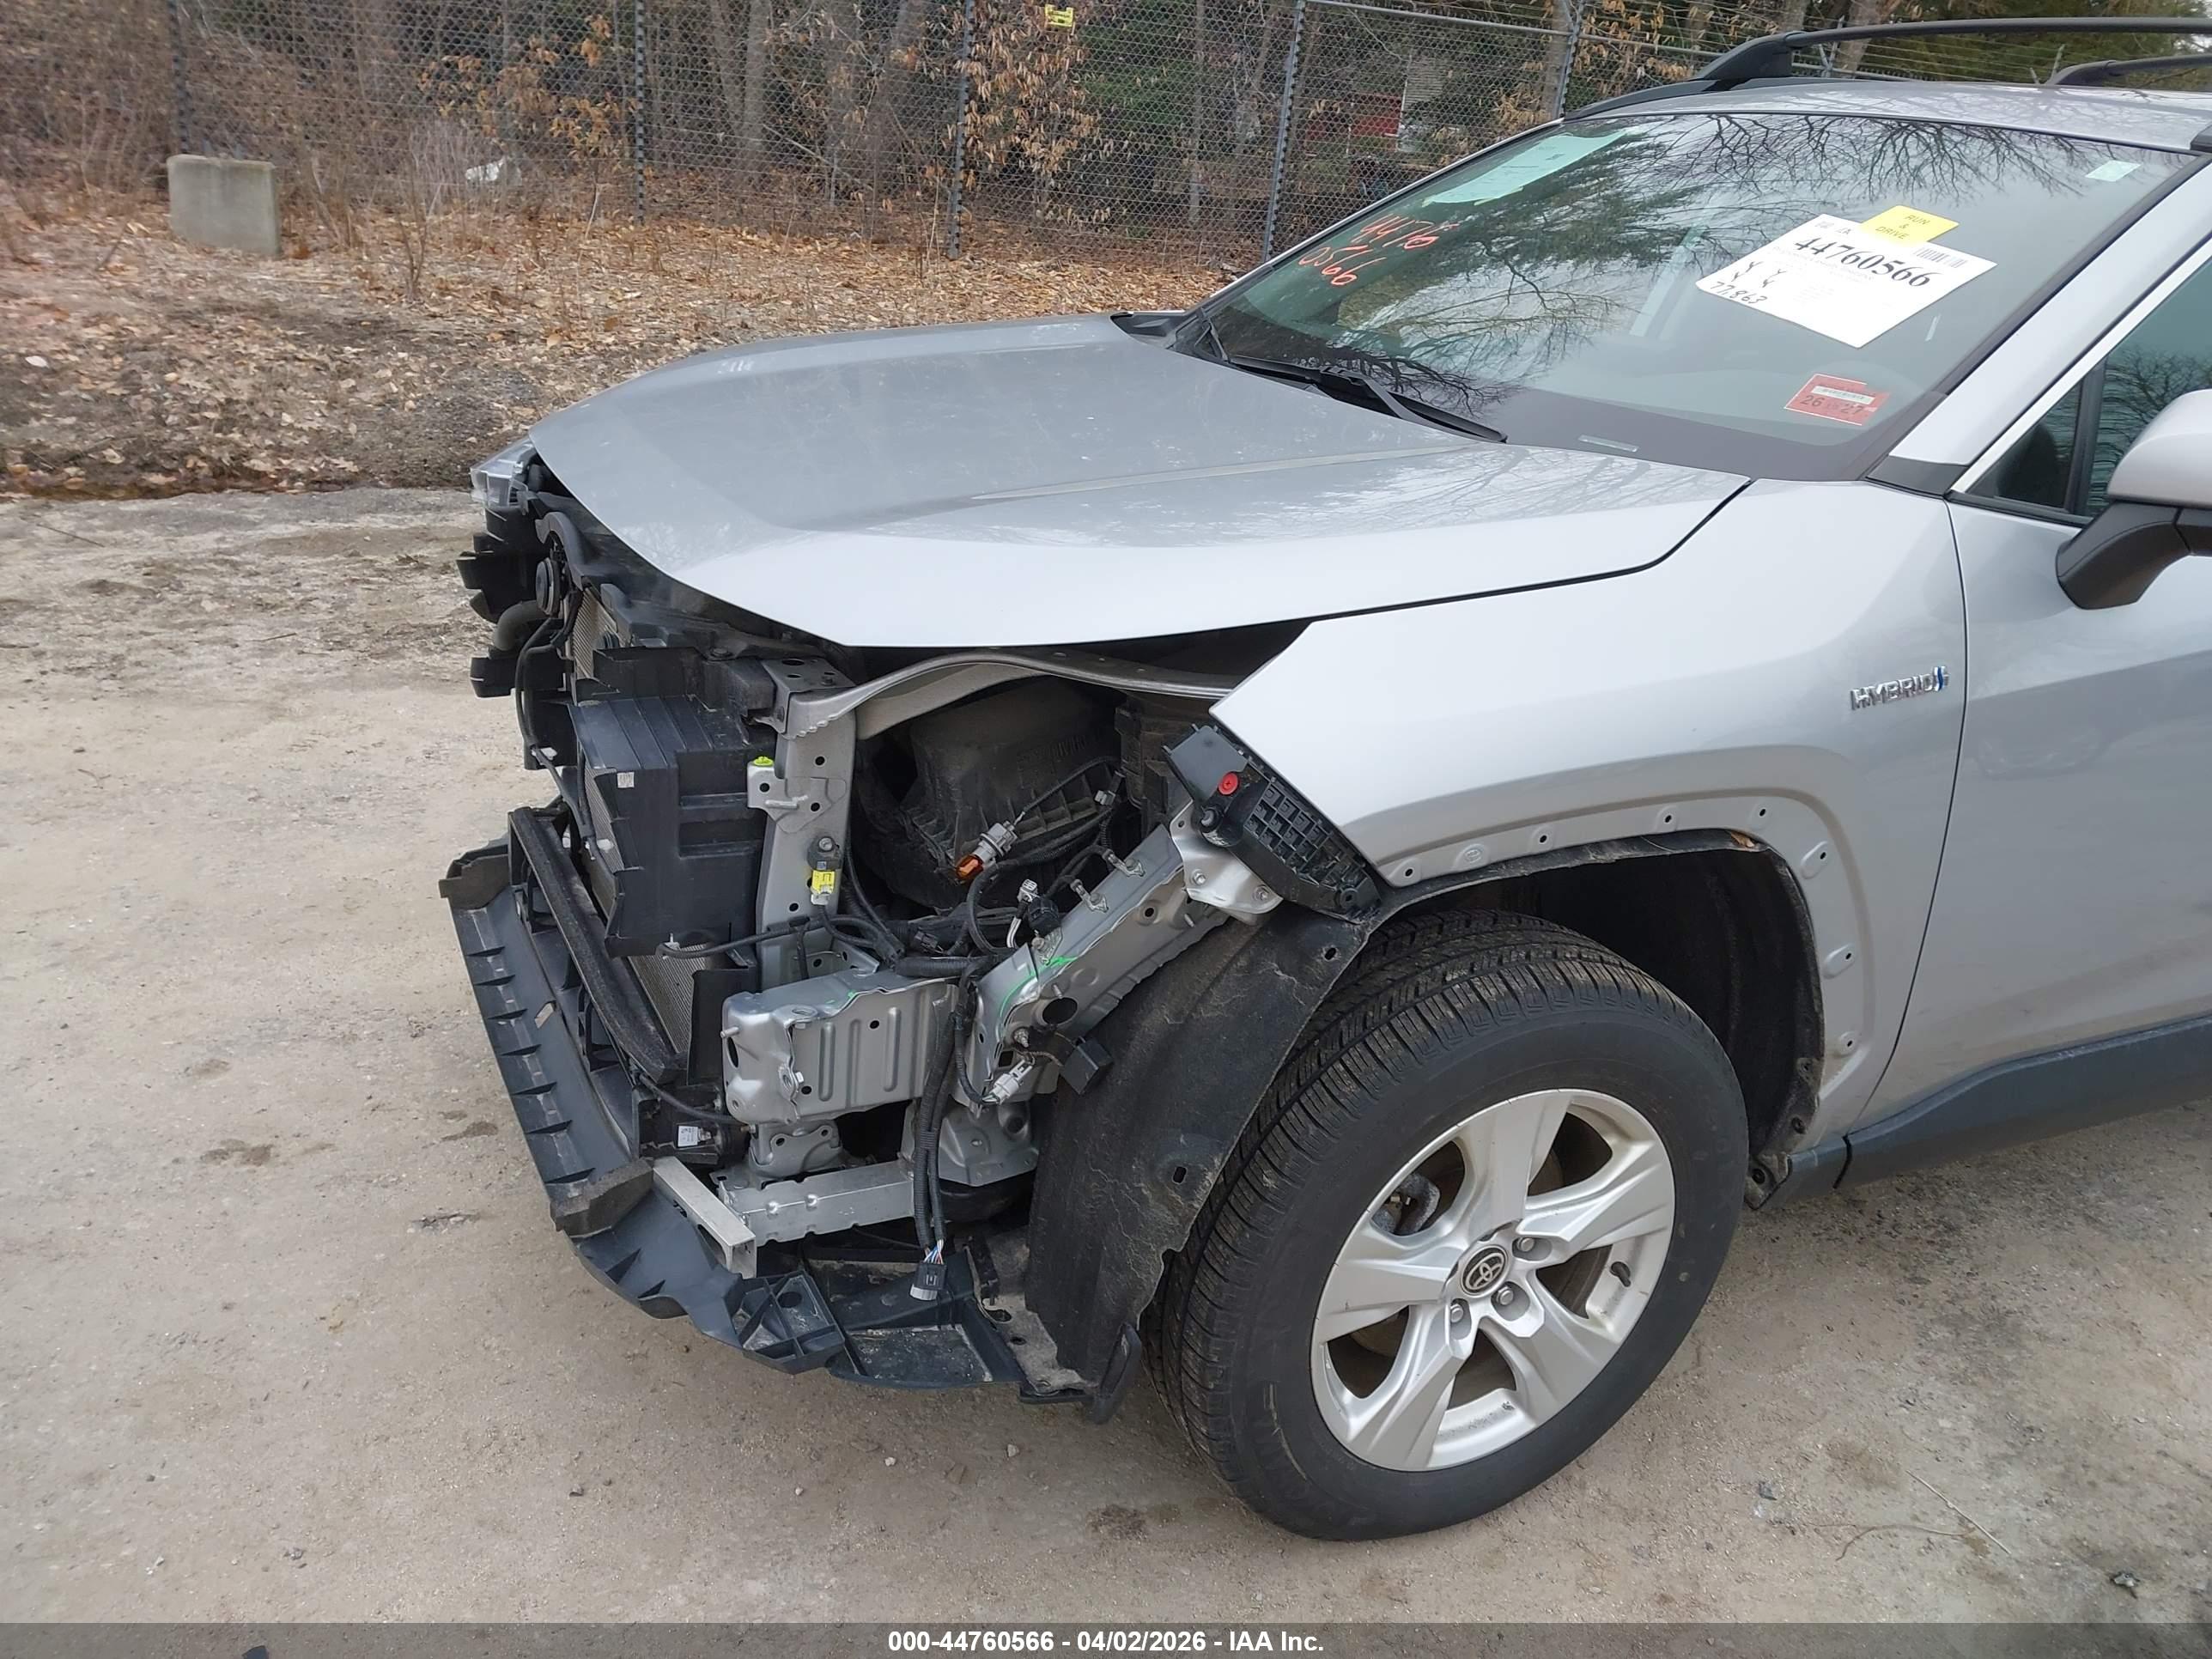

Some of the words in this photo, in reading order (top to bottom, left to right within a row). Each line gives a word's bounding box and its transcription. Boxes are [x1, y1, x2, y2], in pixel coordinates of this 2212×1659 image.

[1904, 214, 1931, 226] RUN
[1874, 225, 1911, 240] DRIVE
[1794, 236, 1944, 288] 44760566
[1710, 281, 1769, 305] 77,863
[1800, 394, 1826, 408] 26
[1850, 673, 1934, 711] HYBRID
